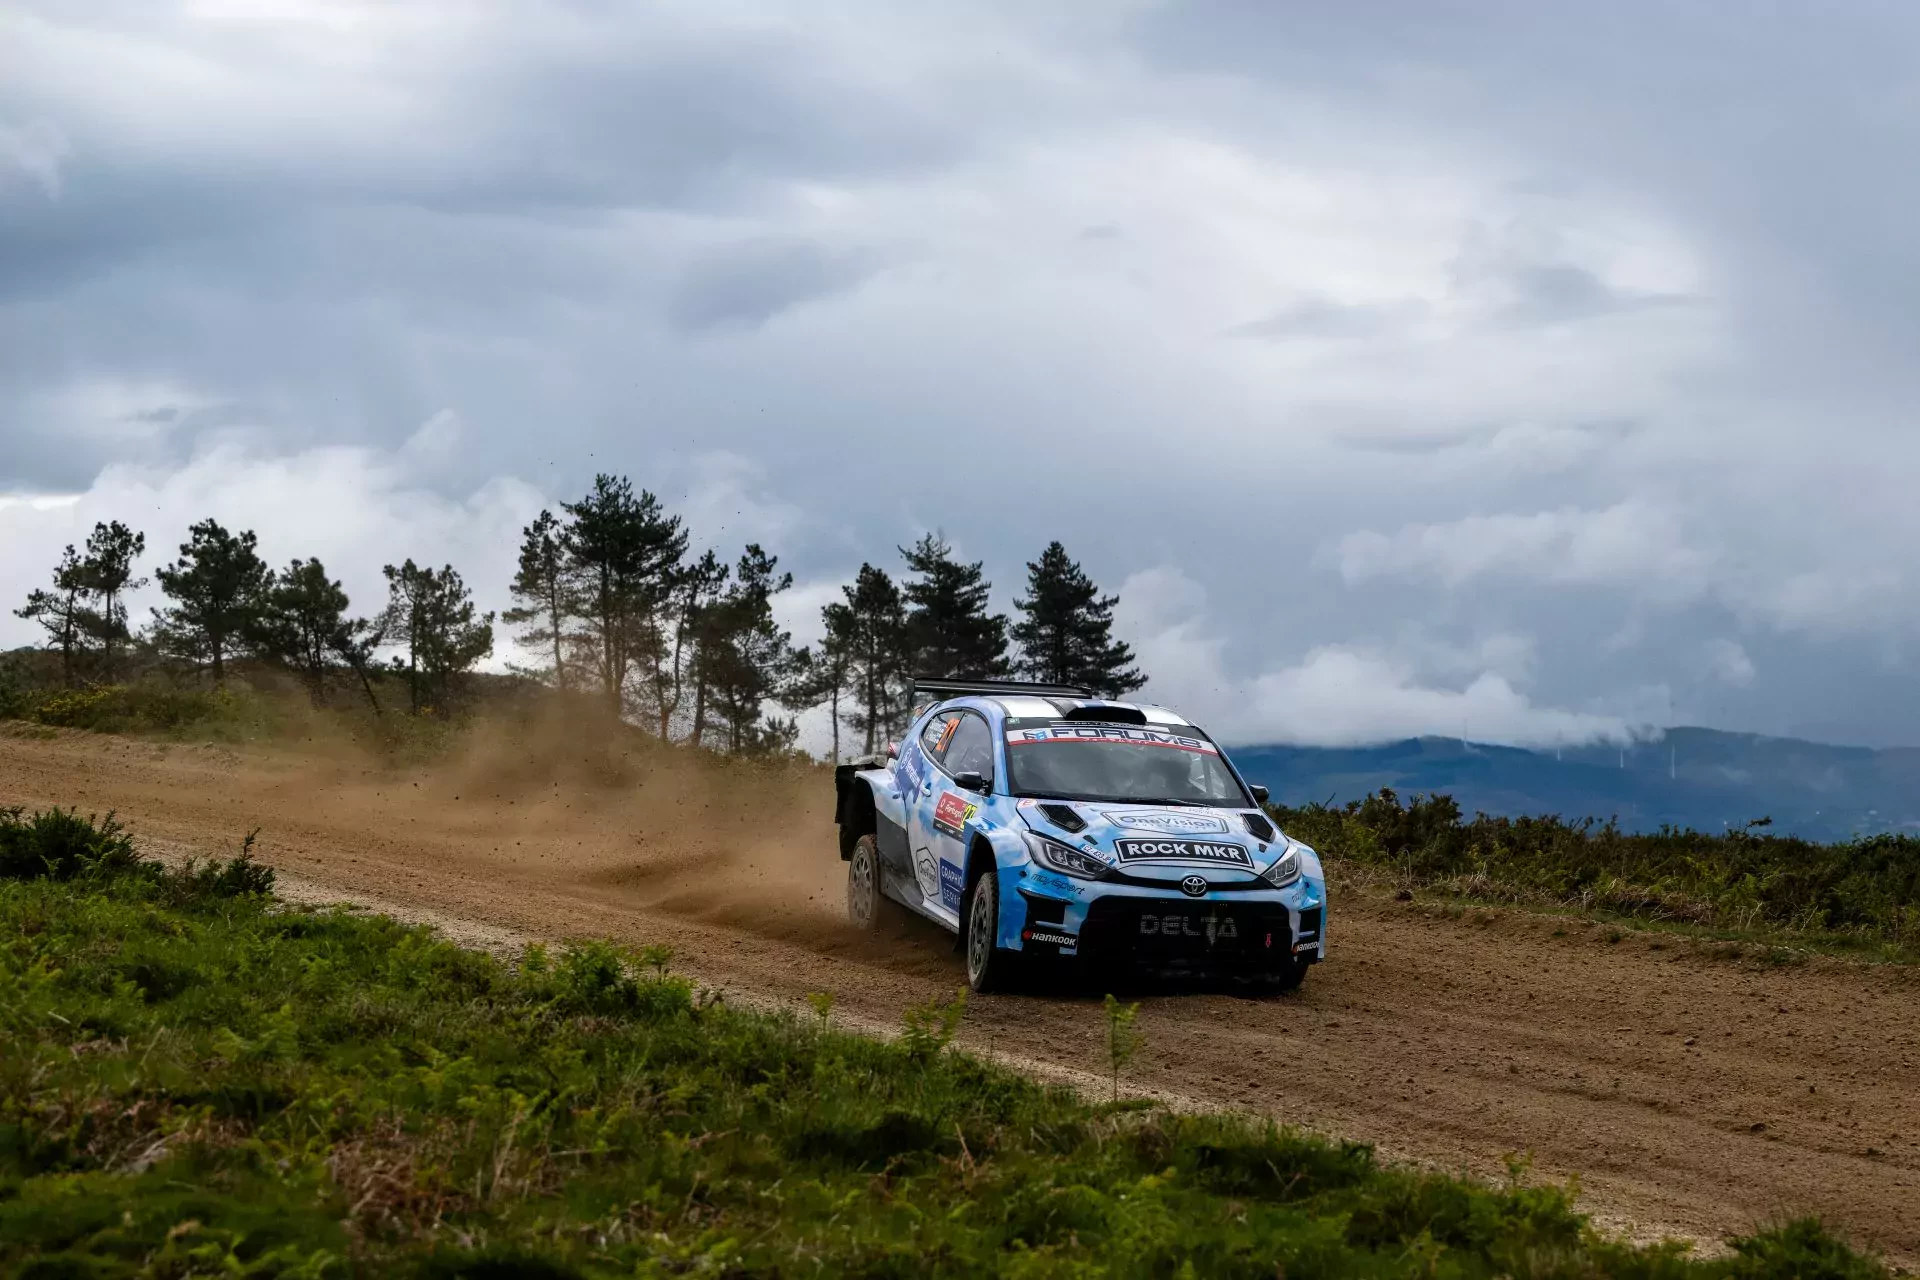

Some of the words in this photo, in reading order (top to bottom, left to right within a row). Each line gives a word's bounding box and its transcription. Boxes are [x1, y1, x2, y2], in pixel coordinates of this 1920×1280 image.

[1120, 815, 1217, 827] OneVision
[1126, 843, 1191, 856] ROCK
[1194, 845, 1242, 861] MKR
[1140, 915, 1238, 937] DELTA
